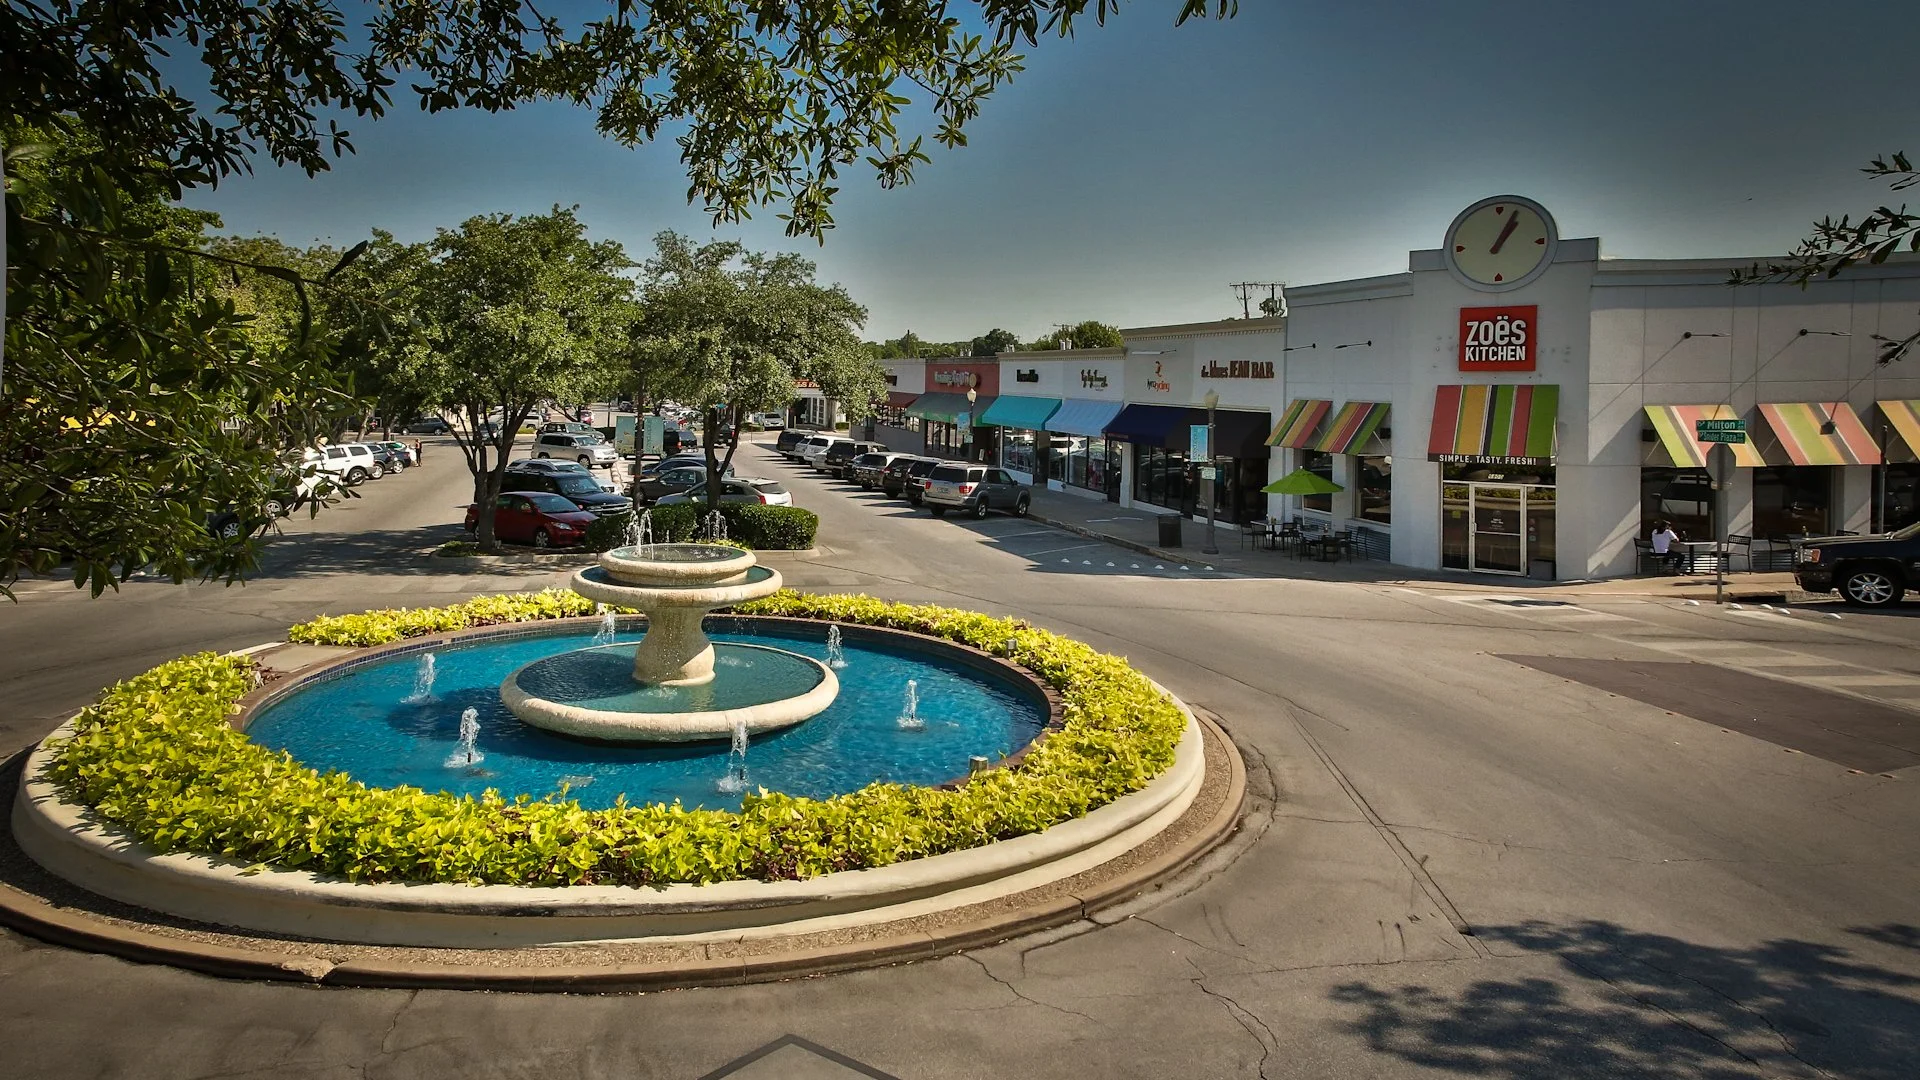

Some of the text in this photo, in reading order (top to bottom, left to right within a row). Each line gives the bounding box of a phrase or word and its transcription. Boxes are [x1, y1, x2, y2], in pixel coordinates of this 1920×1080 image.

[1465, 346, 1526, 361] KITCHEN
[1251, 362, 1274, 378] BAR
[1707, 421, 1736, 430] Milton
[1720, 432, 1737, 442] Plaza
[1439, 454, 1537, 466] SIMPLE. TASTY. FRESH!
